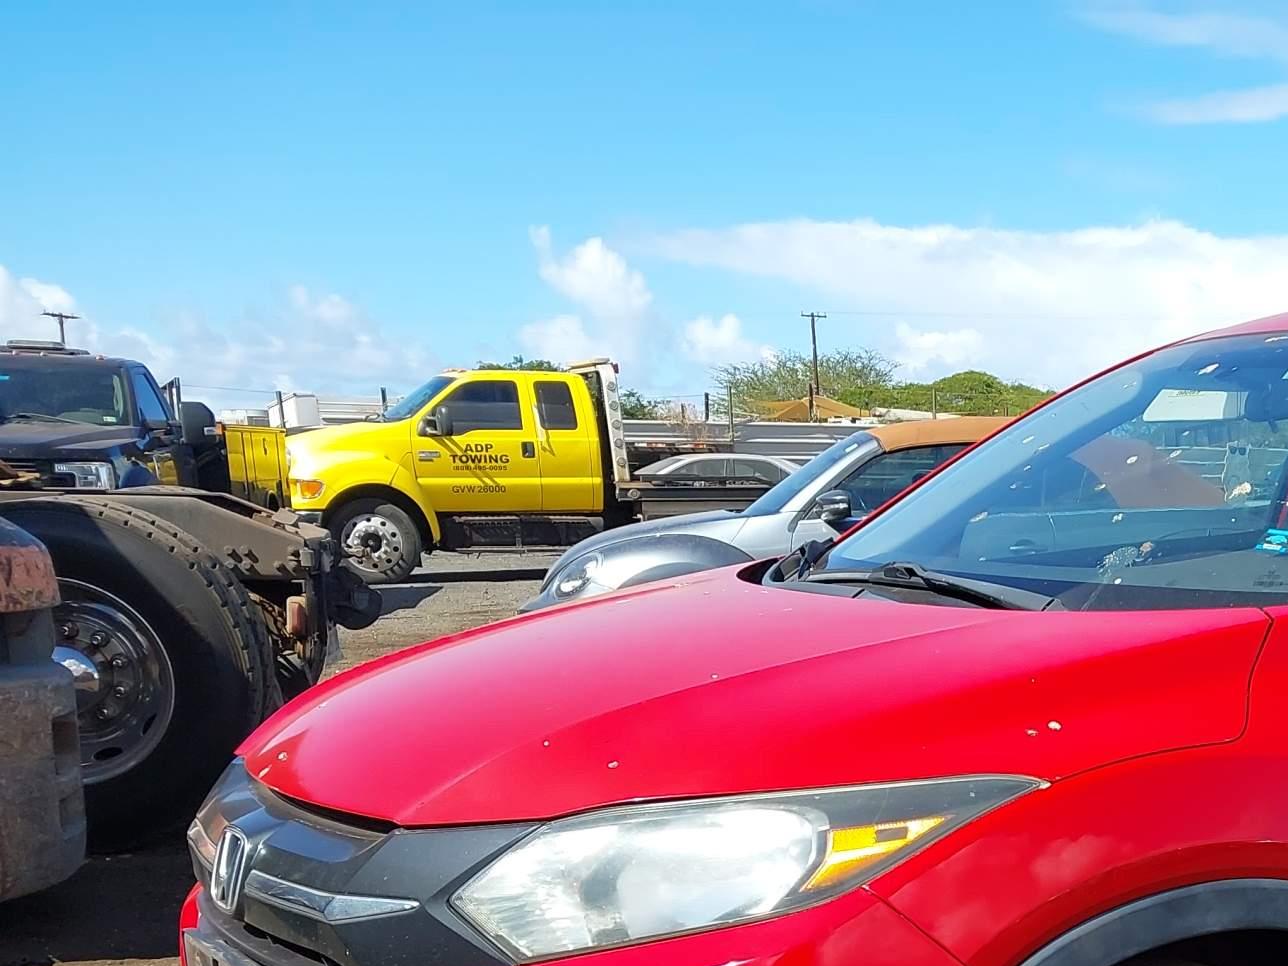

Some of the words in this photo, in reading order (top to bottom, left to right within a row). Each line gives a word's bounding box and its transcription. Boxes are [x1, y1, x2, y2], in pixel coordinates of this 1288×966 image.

[463, 443, 493, 453] ADP
[450, 454, 510, 464] TOWING
[452, 485, 475, 494] GVW
[477, 485, 506, 494] 26000
